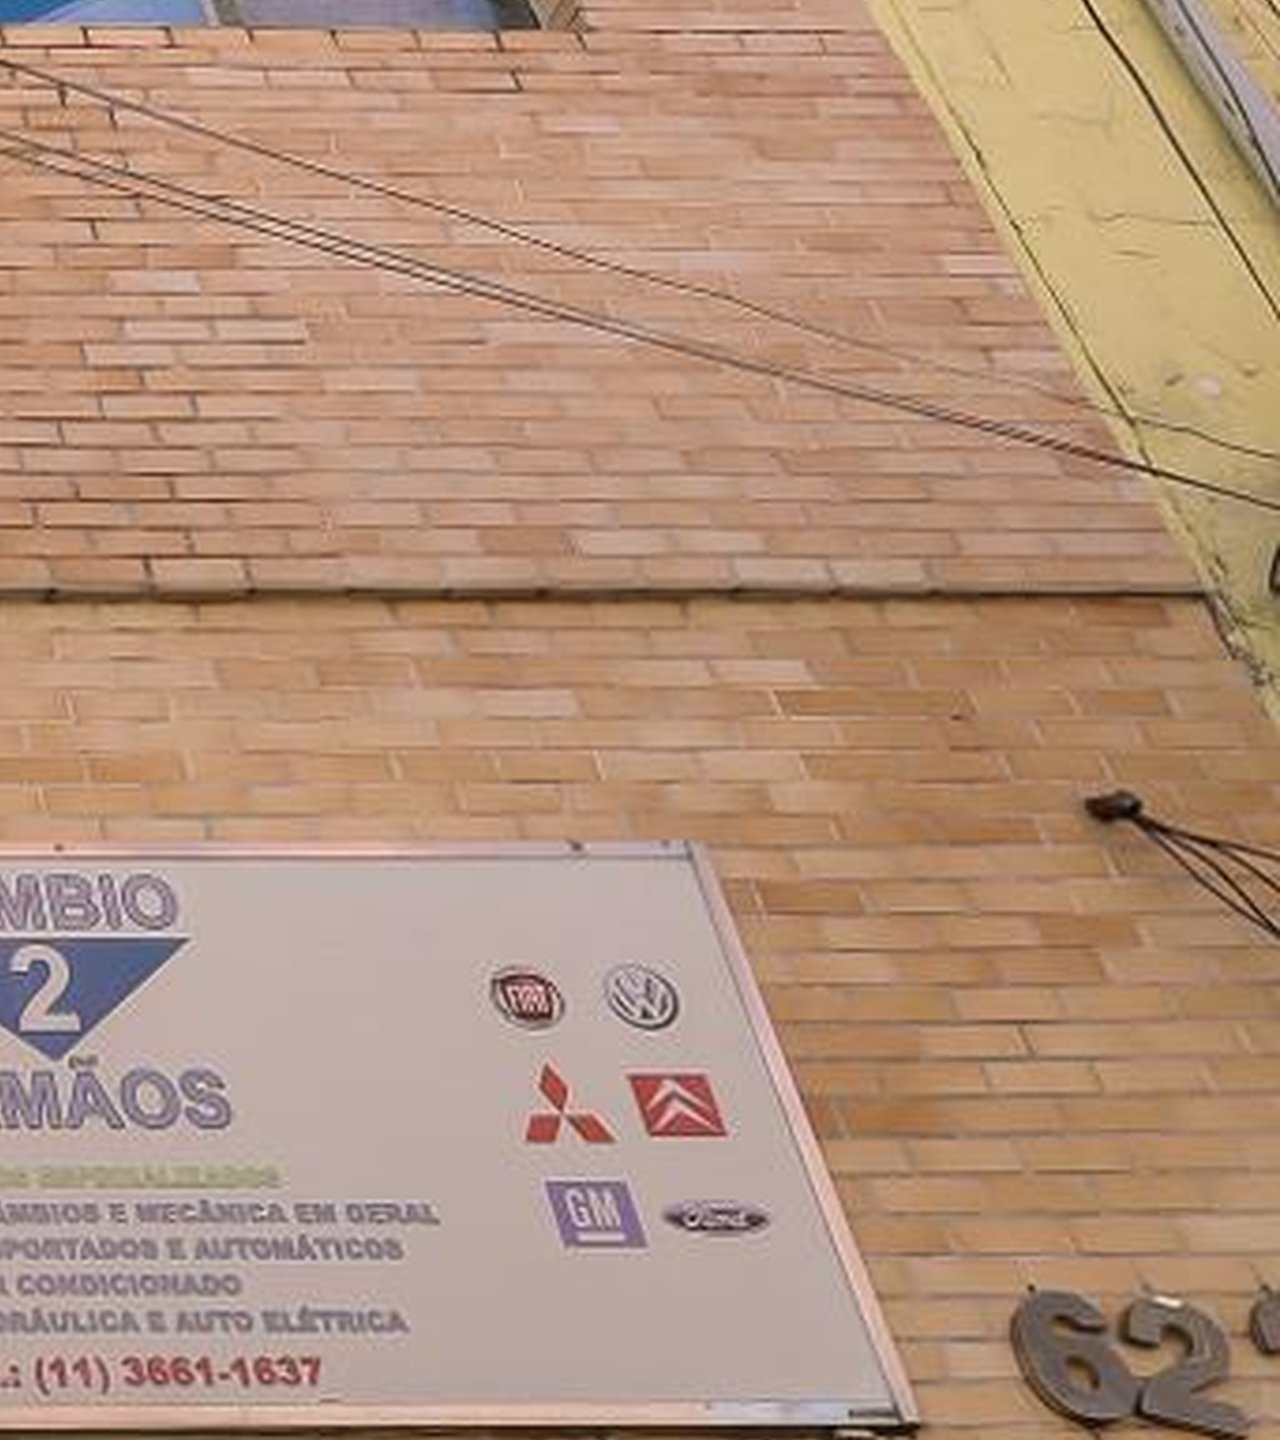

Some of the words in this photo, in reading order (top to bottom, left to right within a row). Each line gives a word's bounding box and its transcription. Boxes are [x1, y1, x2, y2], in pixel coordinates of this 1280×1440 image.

[9, 943, 81, 1033] 2
[108, 1203, 129, 1224] E
[293, 1202, 337, 1223] EM
[564, 1186, 622, 1227] GM
[166, 1238, 188, 1260] E
[194, 1234, 405, 1261] AUTOMÁTICOS
[16, 1273, 243, 1297] CONDICIONADO
[147, 1311, 168, 1333] E
[175, 1310, 254, 1333] AUTO
[260, 1305, 411, 1333] ELÉTRICA
[34, 1356, 112, 1396] (11)
[121, 1355, 322, 1388] 3661-1637
